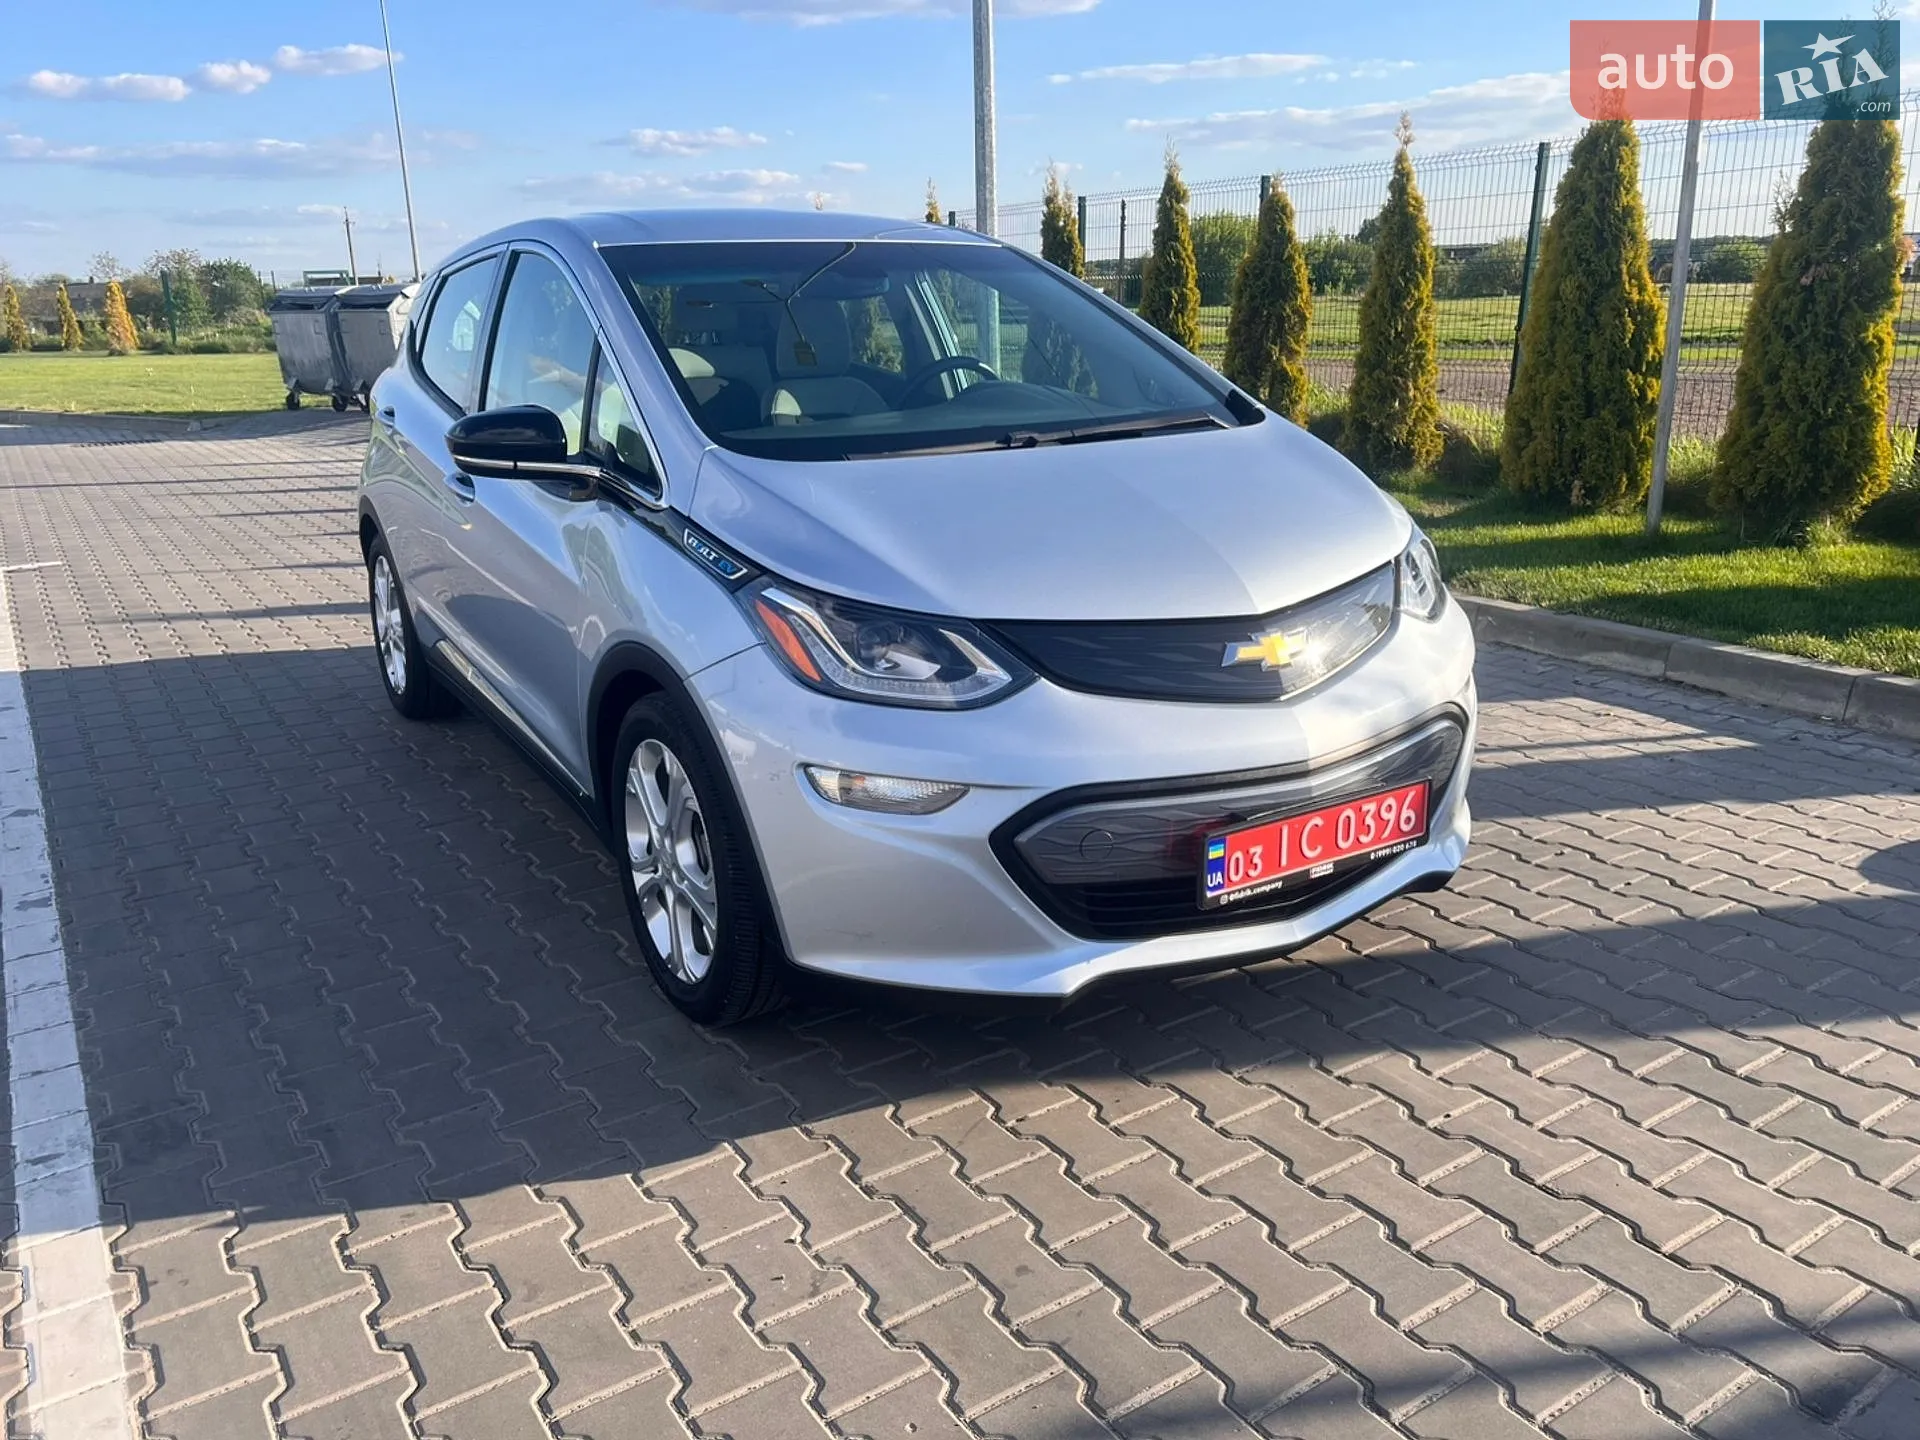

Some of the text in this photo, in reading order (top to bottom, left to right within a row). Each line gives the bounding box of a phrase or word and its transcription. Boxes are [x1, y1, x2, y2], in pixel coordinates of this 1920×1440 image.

[688, 537, 719, 560] BOLT
[1228, 790, 1417, 883] 03 IC 0396
[1207, 872, 1224, 888] UA
